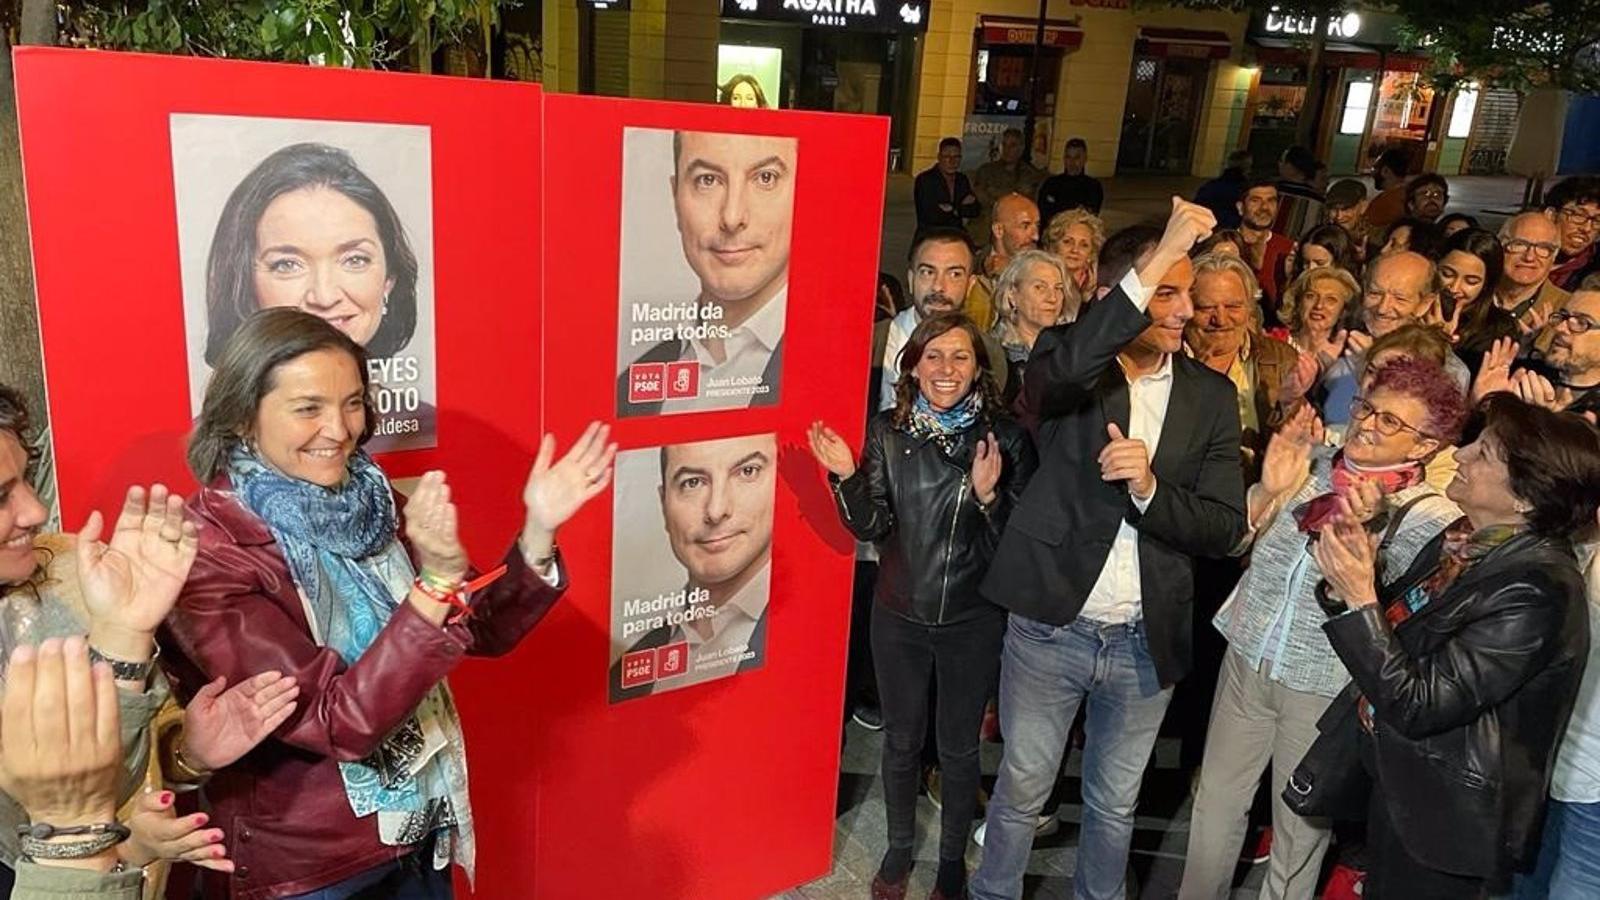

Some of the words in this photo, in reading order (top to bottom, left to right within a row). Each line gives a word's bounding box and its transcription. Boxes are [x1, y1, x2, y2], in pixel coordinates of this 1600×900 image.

[783, 0, 877, 16] AGATHA
[812, 14, 847, 26] PARIS
[632, 303, 698, 321] Madrid
[700, 301, 723, 320] da
[630, 325, 674, 346] para
[367, 357, 418, 383] EYES
[634, 380, 660, 392] PSOE
[370, 387, 419, 414] OTO
[374, 418, 419, 435] aldesa
[623, 589, 686, 618] Madrid
[688, 587, 710, 604] da
[622, 616, 664, 638] para
[626, 665, 651, 679] PSOE
